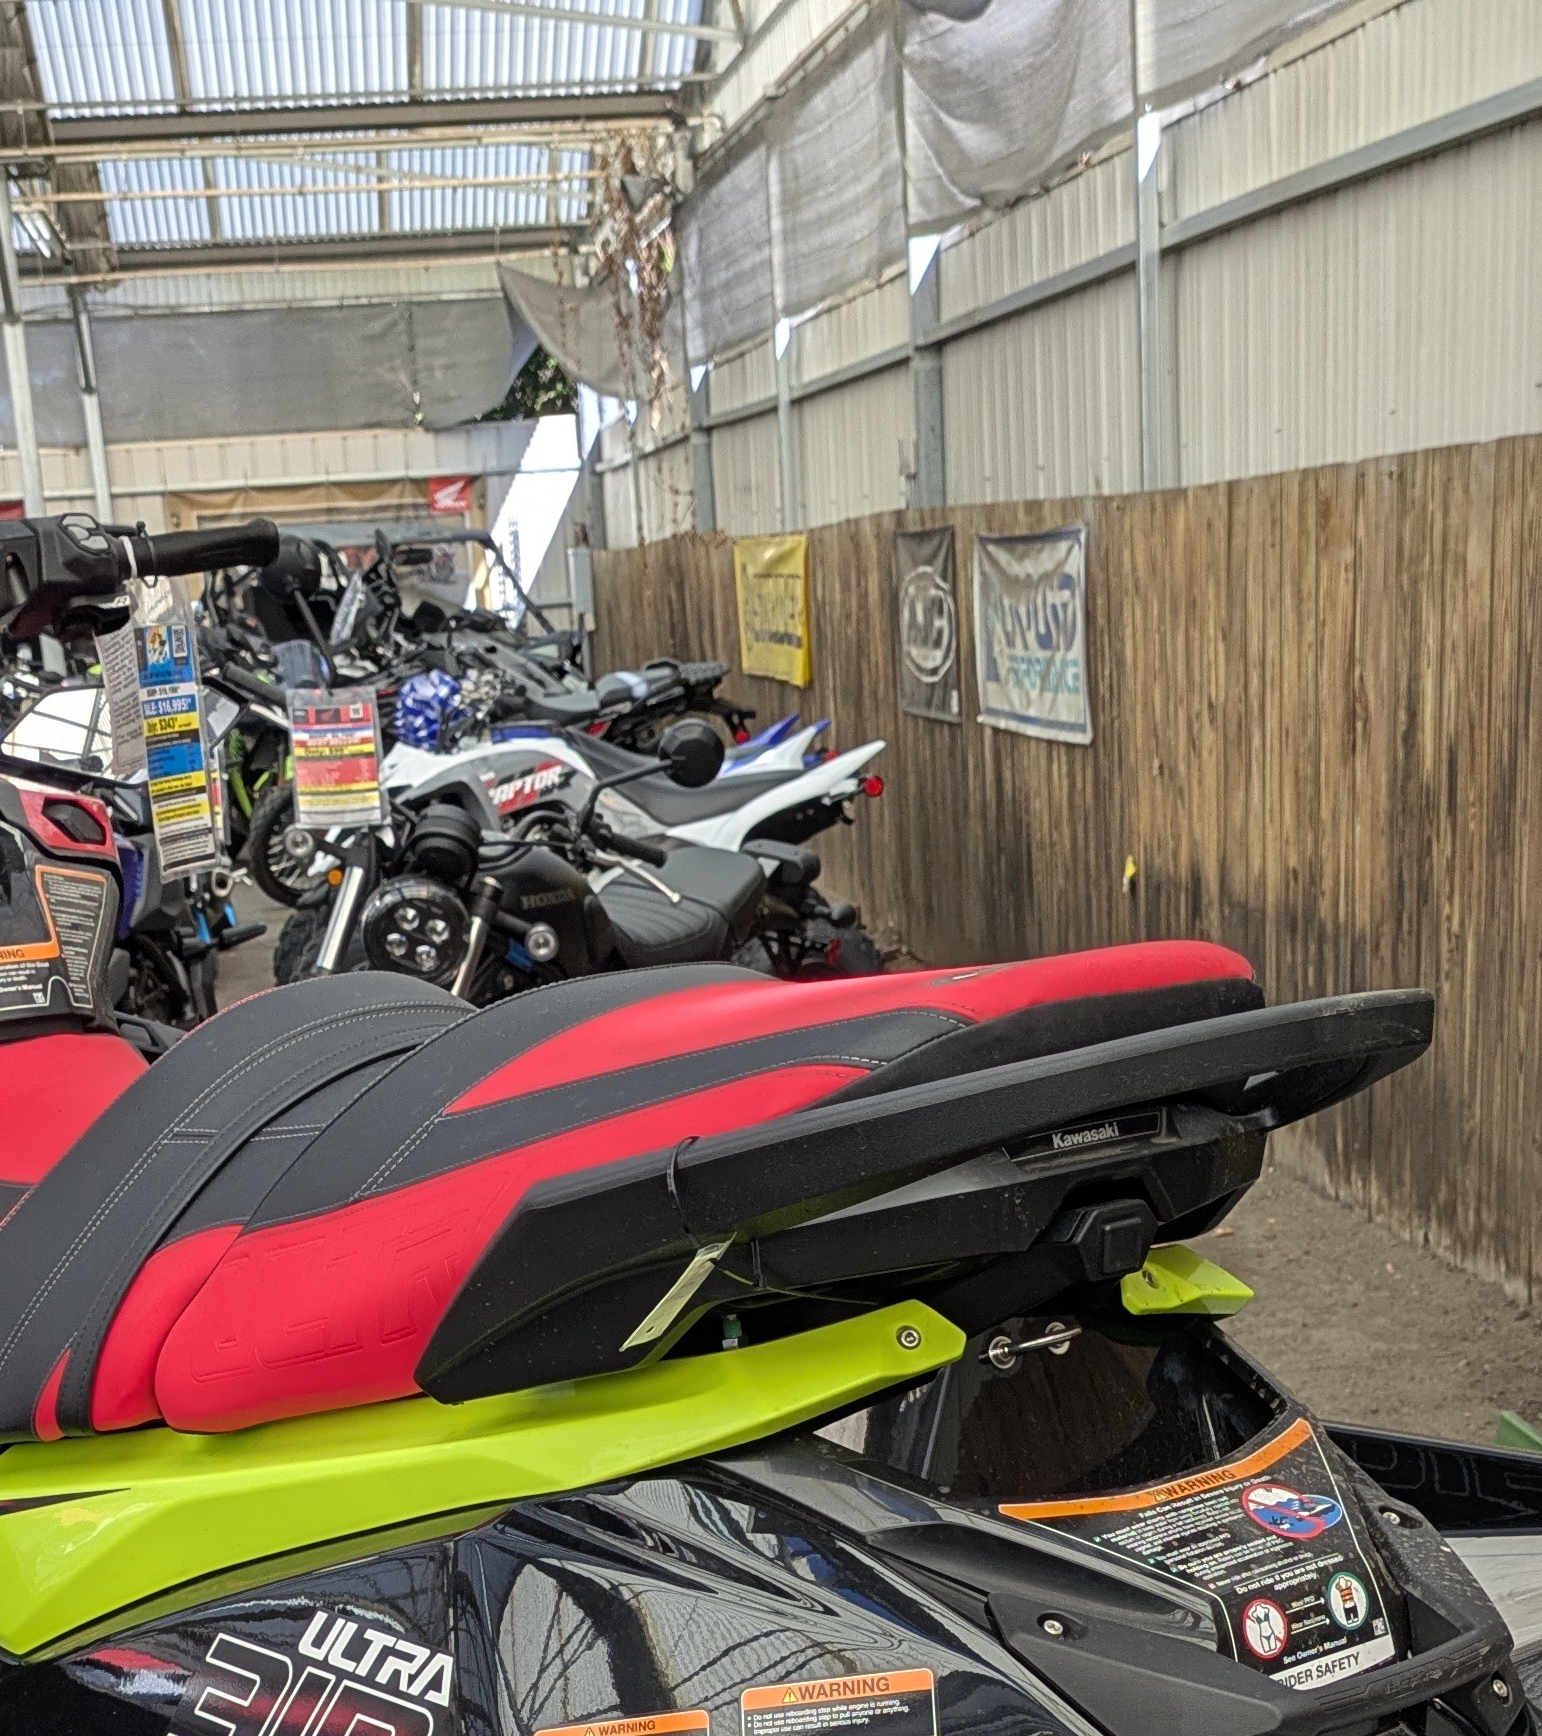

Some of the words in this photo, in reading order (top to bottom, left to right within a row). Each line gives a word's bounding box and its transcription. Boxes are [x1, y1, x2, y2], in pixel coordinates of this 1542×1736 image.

[1053, 1121, 1120, 1149] Kawasaki
[1161, 1469, 1237, 1499] WARNING
[298, 1610, 454, 1707] ULTRA
[1316, 1652, 1361, 1678] SAFETY
[798, 1677, 890, 1701] WARNING
[599, 1720, 656, 1736] WARNING
